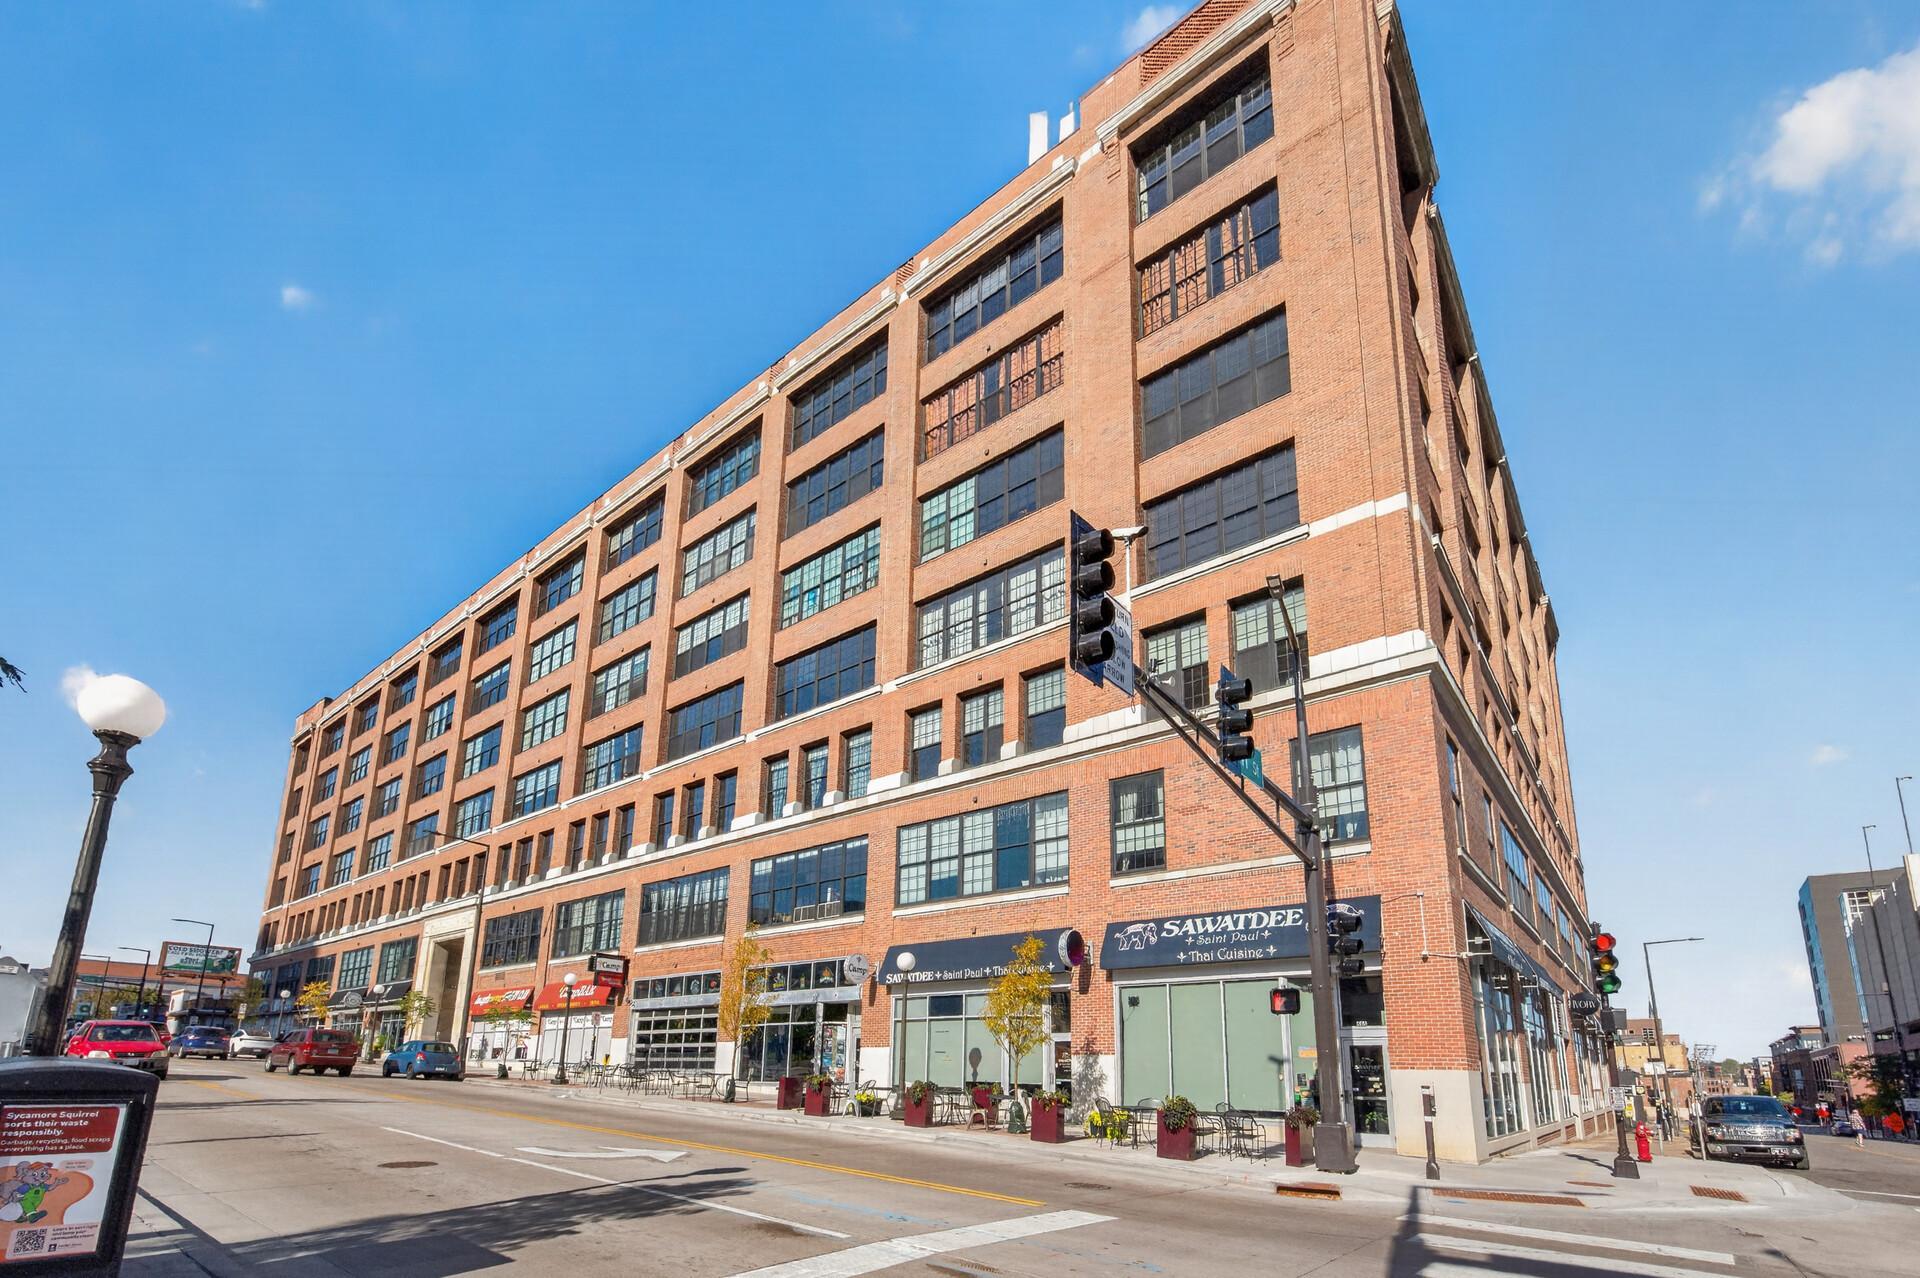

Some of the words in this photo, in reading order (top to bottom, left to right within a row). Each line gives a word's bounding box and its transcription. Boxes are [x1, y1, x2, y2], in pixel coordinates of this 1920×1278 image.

[1161, 908, 1303, 937] SAWATDEE
[1197, 934, 1226, 945] Saint
[1230, 931, 1260, 943] Paul
[1188, 950, 1214, 962] Thai
[1217, 948, 1264, 961] Cuisine
[849, 963, 867, 976] Camp
[942, 969, 963, 980] Saint
[964, 966, 983, 979] Paul
[6, 1112, 58, 1120] Sycamore
[59, 1111, 99, 1120] Squirrel
[2, 1129, 64, 1138] responsibly.
